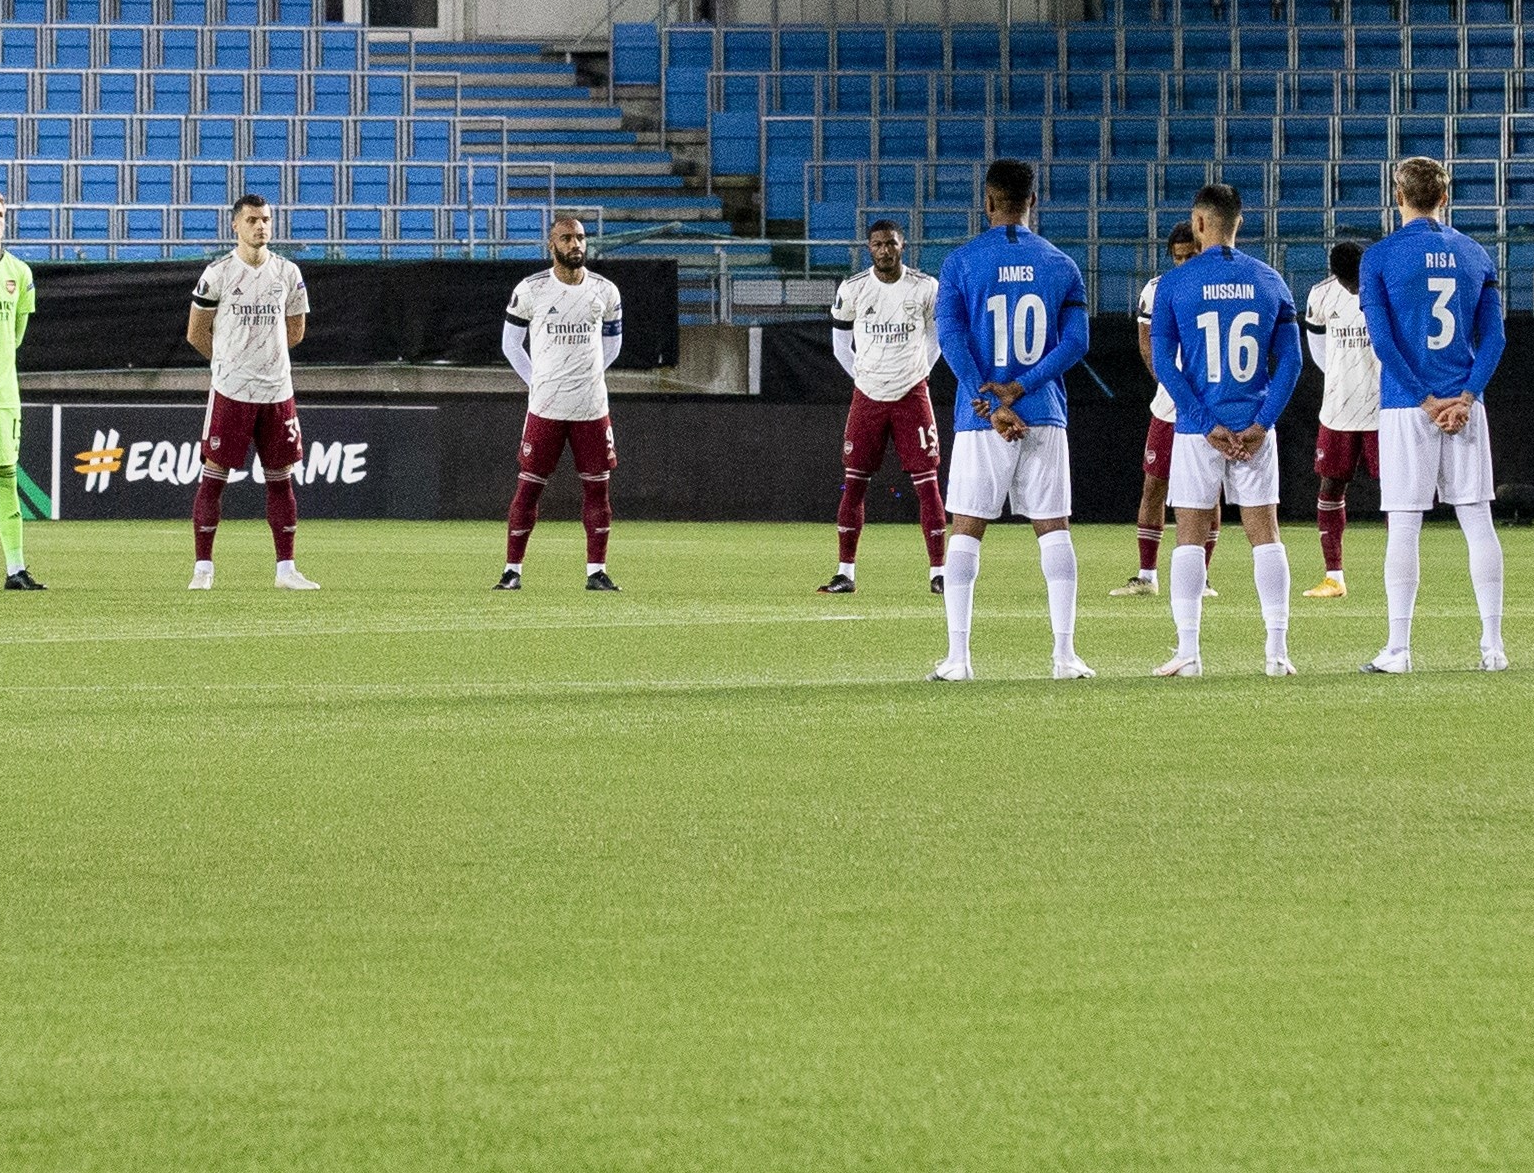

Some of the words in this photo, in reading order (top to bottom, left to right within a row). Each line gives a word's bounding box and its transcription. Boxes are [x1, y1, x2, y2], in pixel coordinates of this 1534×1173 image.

[1425, 252, 1457, 269] RISA
[998, 265, 1034, 283] JAMES
[1203, 284, 1255, 301] HUSSAIN
[1427, 277, 1456, 351] 3
[987, 293, 1047, 367] 10
[1330, 325, 1367, 338] Emirat
[1196, 310, 1260, 384] 16
